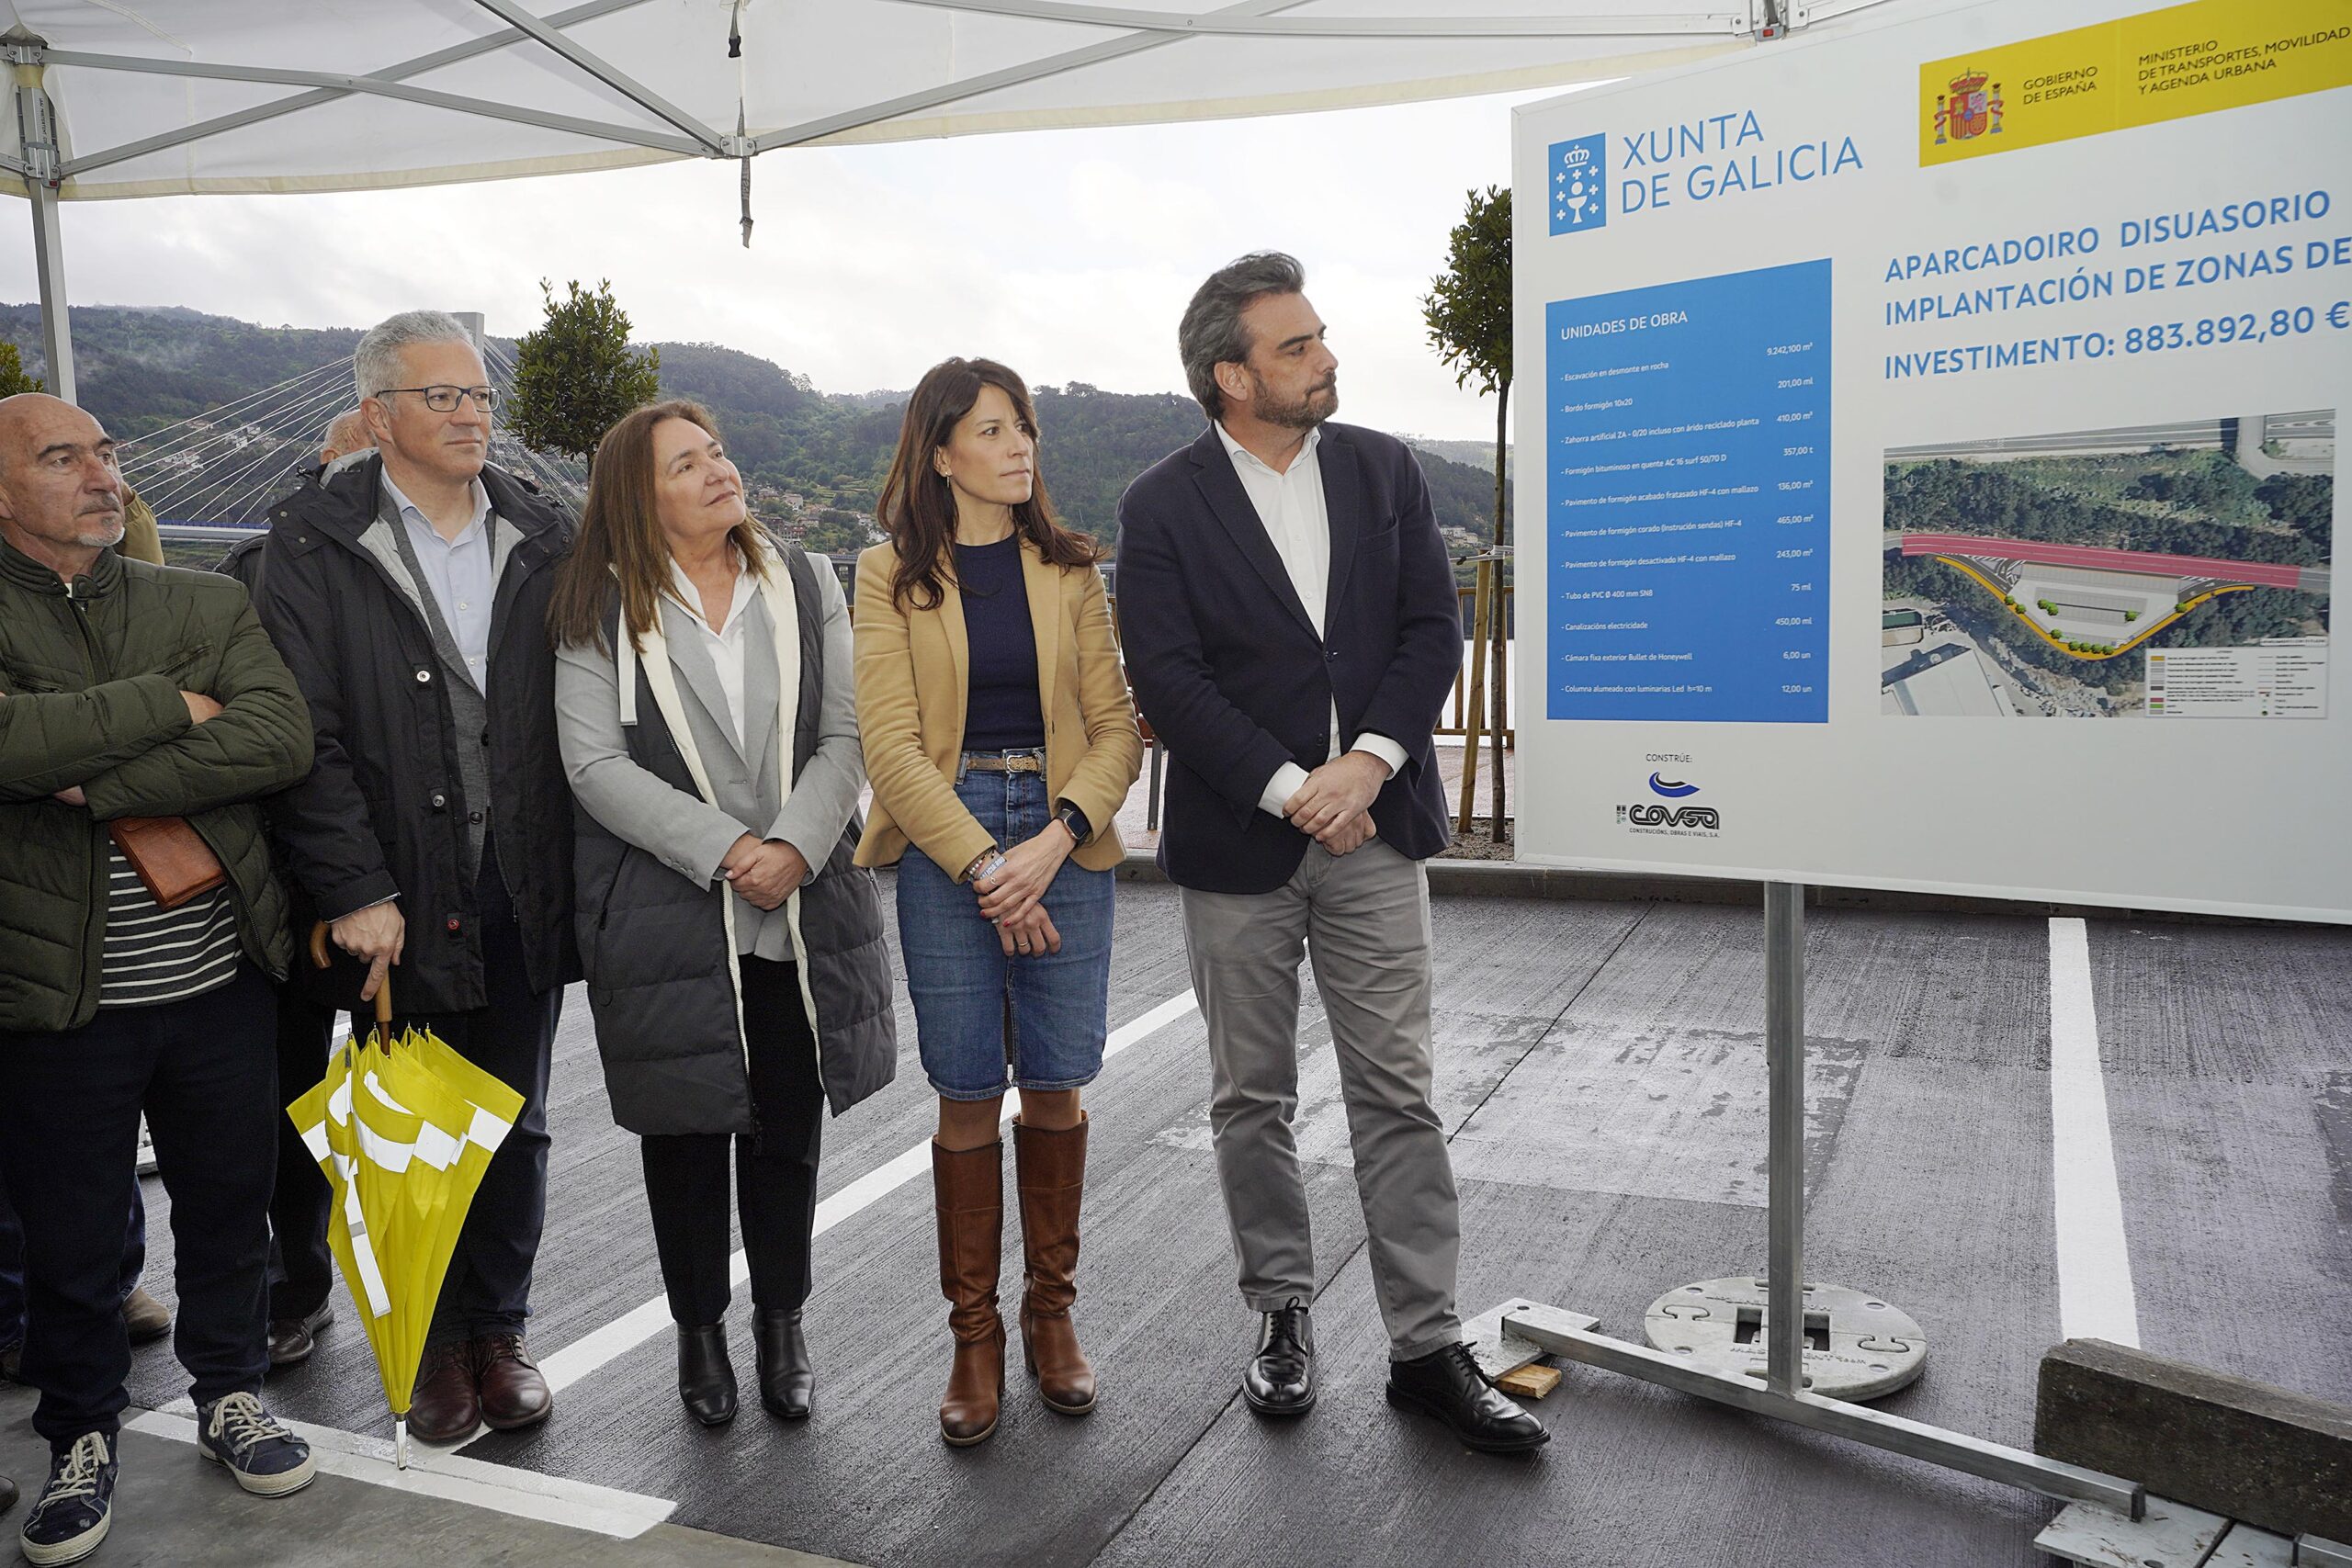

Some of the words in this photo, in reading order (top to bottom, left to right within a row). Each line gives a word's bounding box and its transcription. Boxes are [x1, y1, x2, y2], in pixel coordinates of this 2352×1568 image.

[2139, 39, 2218, 65] MINISTERIO
[2139, 68, 2159, 82] DE
[2160, 46, 2262, 76] TRANSPORTES,
[2265, 27, 2351, 53] MOVILIDAD
[2023, 66, 2098, 90] GOBIERNO
[2139, 83, 2149, 96] Y
[2151, 72, 2210, 93] AGENDA
[2213, 58, 2277, 80] URBANA
[2023, 92, 2041, 105] DE
[2044, 80, 2098, 102] ESPAÑA
[1623, 109, 1765, 170] XUNTA
[1623, 173, 1670, 214] DE
[1687, 136, 1863, 201] GALICIA
[1885, 227, 2099, 283] APARCADOIRO
[2120, 190, 2331, 248] DISUASORIO
[1886, 266, 2113, 325] IMPLANTACIÓN
[2125, 267, 2165, 294] DE
[2176, 245, 2293, 287] ZONAS
[2306, 236, 2352, 269] DE
[1561, 320, 1625, 340] UNIDADES
[1630, 316, 1647, 330] DE
[1651, 310, 1688, 327] OBRA
[1885, 332, 2115, 378] INVESTIMENTO:
[2125, 306, 2314, 354] 883.892,80
[2324, 301, 2351, 329] €
[1608, 365, 1639, 376] desmonte
[1650, 361, 1668, 370] rocha
[1778, 378, 1802, 389] 201,00
[1565, 403, 1583, 412] Bordo
[1584, 400, 1612, 412] formigón
[1614, 398, 1633, 407] 10x20
[1777, 412, 1802, 423] 410,00
[1565, 434, 1589, 444] Zahorra
[1589, 432, 1616, 441] artificial
[1632, 428, 1647, 436] 0/20
[1648, 425, 1671, 435] incluso
[1704, 419, 1736, 429] reciclado
[1736, 417, 1759, 428] planta
[1565, 466, 1594, 477] Formigón
[1595, 462, 1630, 472] bituminoso
[1641, 459, 1663, 469] quente
[1685, 456, 1698, 464] surf
[1700, 454, 1720, 463] 50/70
[1565, 497, 1598, 506] Pavimento
[1608, 493, 1637, 504] formigón
[1638, 491, 1665, 501] acabado
[1699, 488, 1716, 496] HF-4
[1731, 484, 1758, 493] mallazo
[1565, 528, 1598, 537] Pavimento
[1608, 525, 1637, 536] formigón
[1724, 519, 1742, 527] HF-4
[1565, 559, 1598, 569] Pavimento
[1608, 558, 1637, 568] formigón
[1637, 556, 1676, 565] desactivado
[1677, 555, 1694, 563] HF-4
[1709, 553, 1736, 561] mallazo
[1607, 621, 1647, 629] electricidade
[1775, 617, 1801, 626] 450,00
[1658, 652, 1692, 661] Honeywell
[1782, 651, 1800, 660] 6,00
[1645, 753, 1692, 762] CONSTRÚE:
